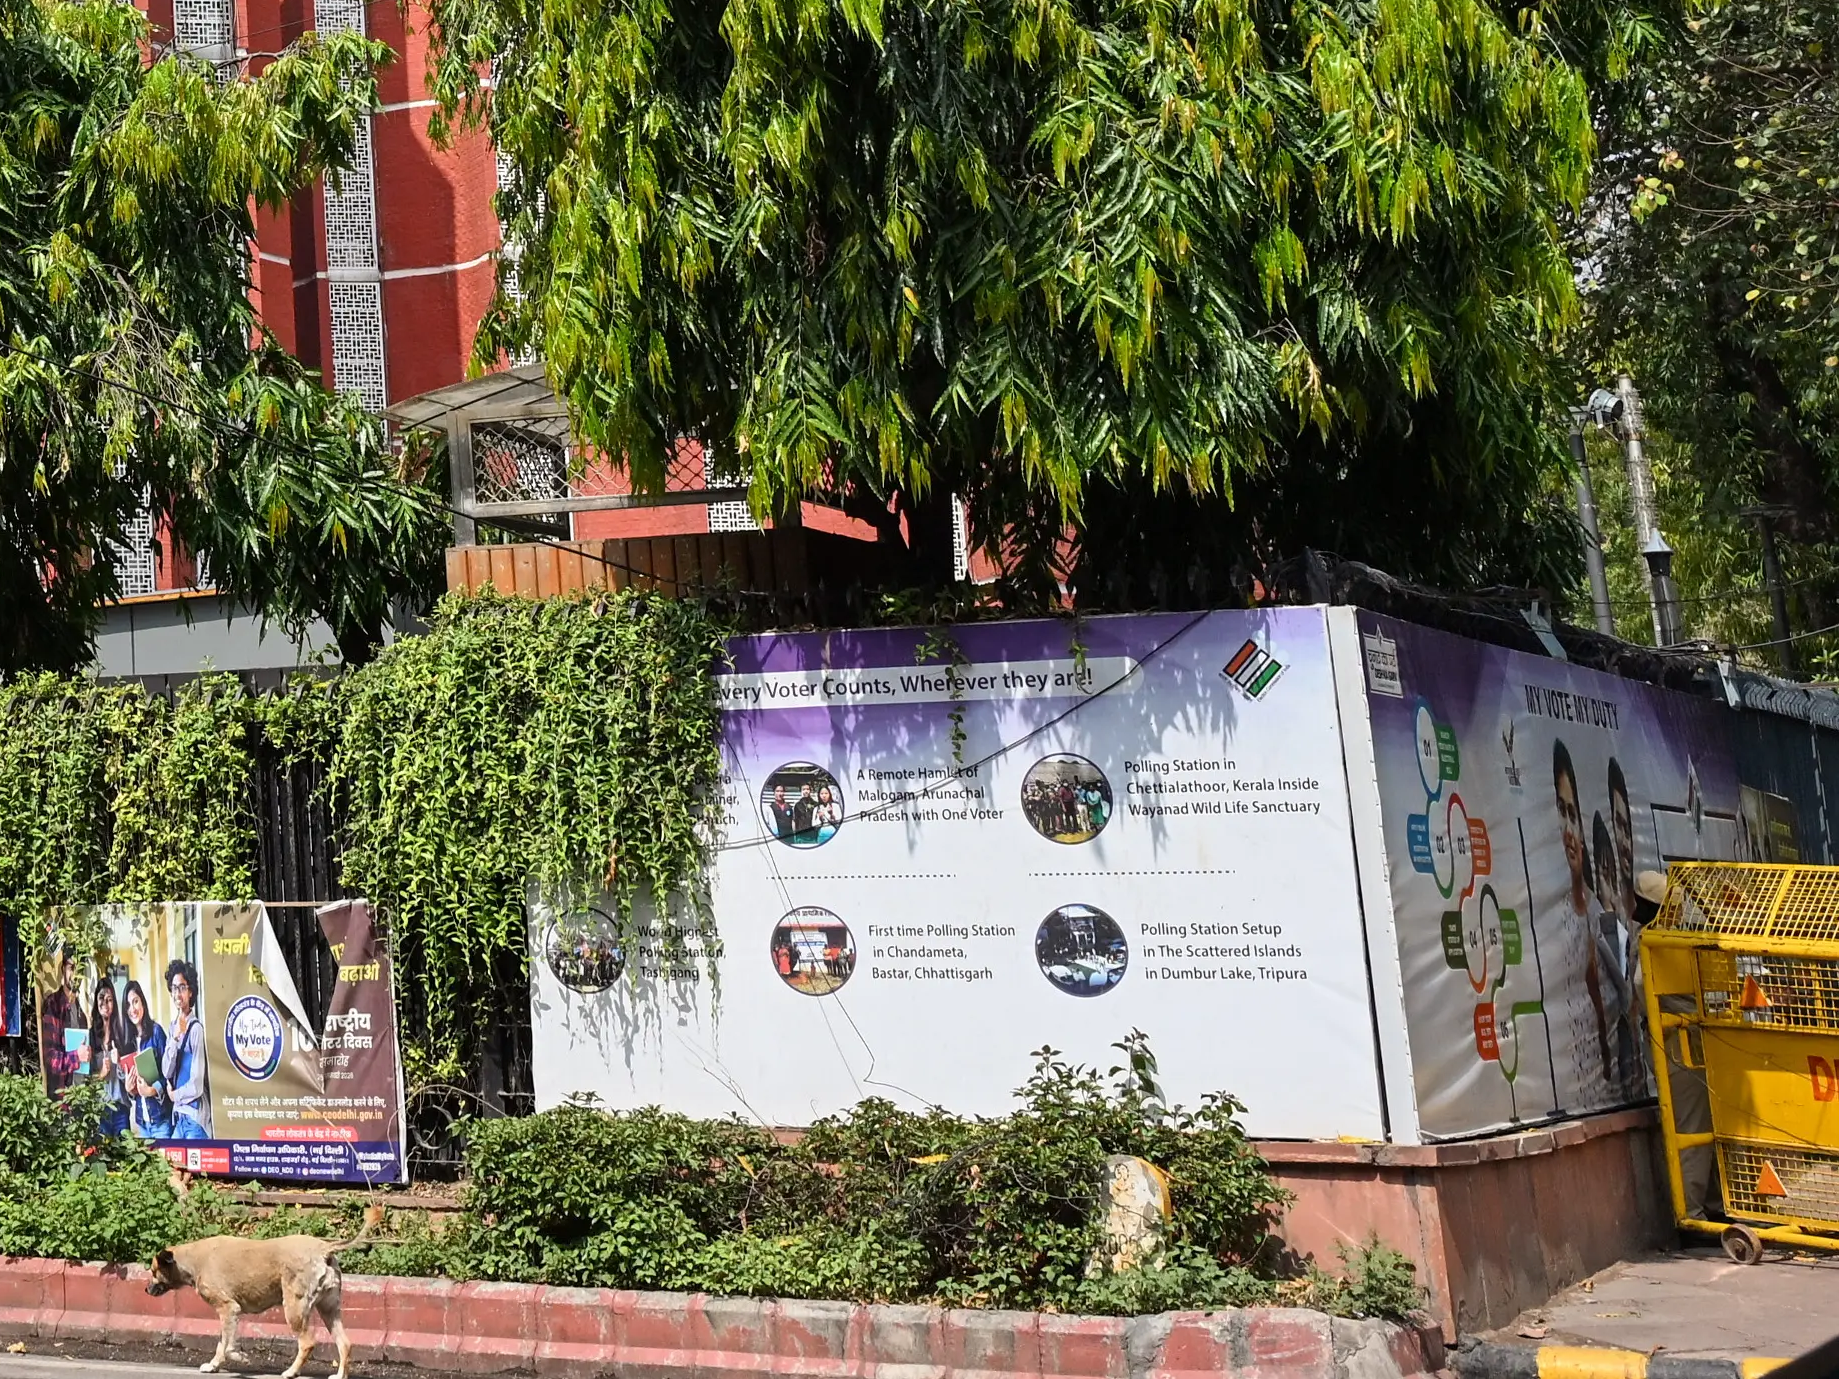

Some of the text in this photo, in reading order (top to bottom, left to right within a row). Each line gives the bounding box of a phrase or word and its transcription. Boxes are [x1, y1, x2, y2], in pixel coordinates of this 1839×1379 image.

[765, 681, 818, 698] Voter
[823, 677, 896, 696] Counts,
[899, 673, 997, 693] Wherever
[1002, 670, 1048, 692] they
[1524, 684, 1619, 730] MY VOTE MY DUTY
[1423, 739, 1432, 758] 01
[857, 769, 865, 781] A
[868, 767, 916, 781] Remote
[965, 765, 979, 779] of
[1124, 757, 1237, 775] Polling Station in
[858, 785, 985, 804] Malogam, Arunachal
[1126, 777, 1320, 795] Chettialathoor, Kerala Inside
[860, 807, 1005, 822] Pradesh with One Voter
[1128, 800, 1321, 819] Wayanad Wild Life Sanctuary
[1435, 835, 1446, 854] 02
[1457, 836, 1466, 855] 03
[637, 925, 672, 938] Wod
[868, 923, 1016, 940] First time Polling Station
[1140, 922, 1283, 939] Polling Station Setup
[681, 946, 726, 959] Staton,
[873, 944, 968, 959] in Chandameta,
[1143, 943, 1303, 958] in The Scattered Islands
[640, 966, 699, 981] Tashgang
[872, 966, 993, 983] Bastar, Chhattisgarh
[1145, 966, 1308, 982] in Dumbur Lake, Tripura
[235, 1033, 271, 1048] My Vote
[1807, 1055, 1839, 1102] D
